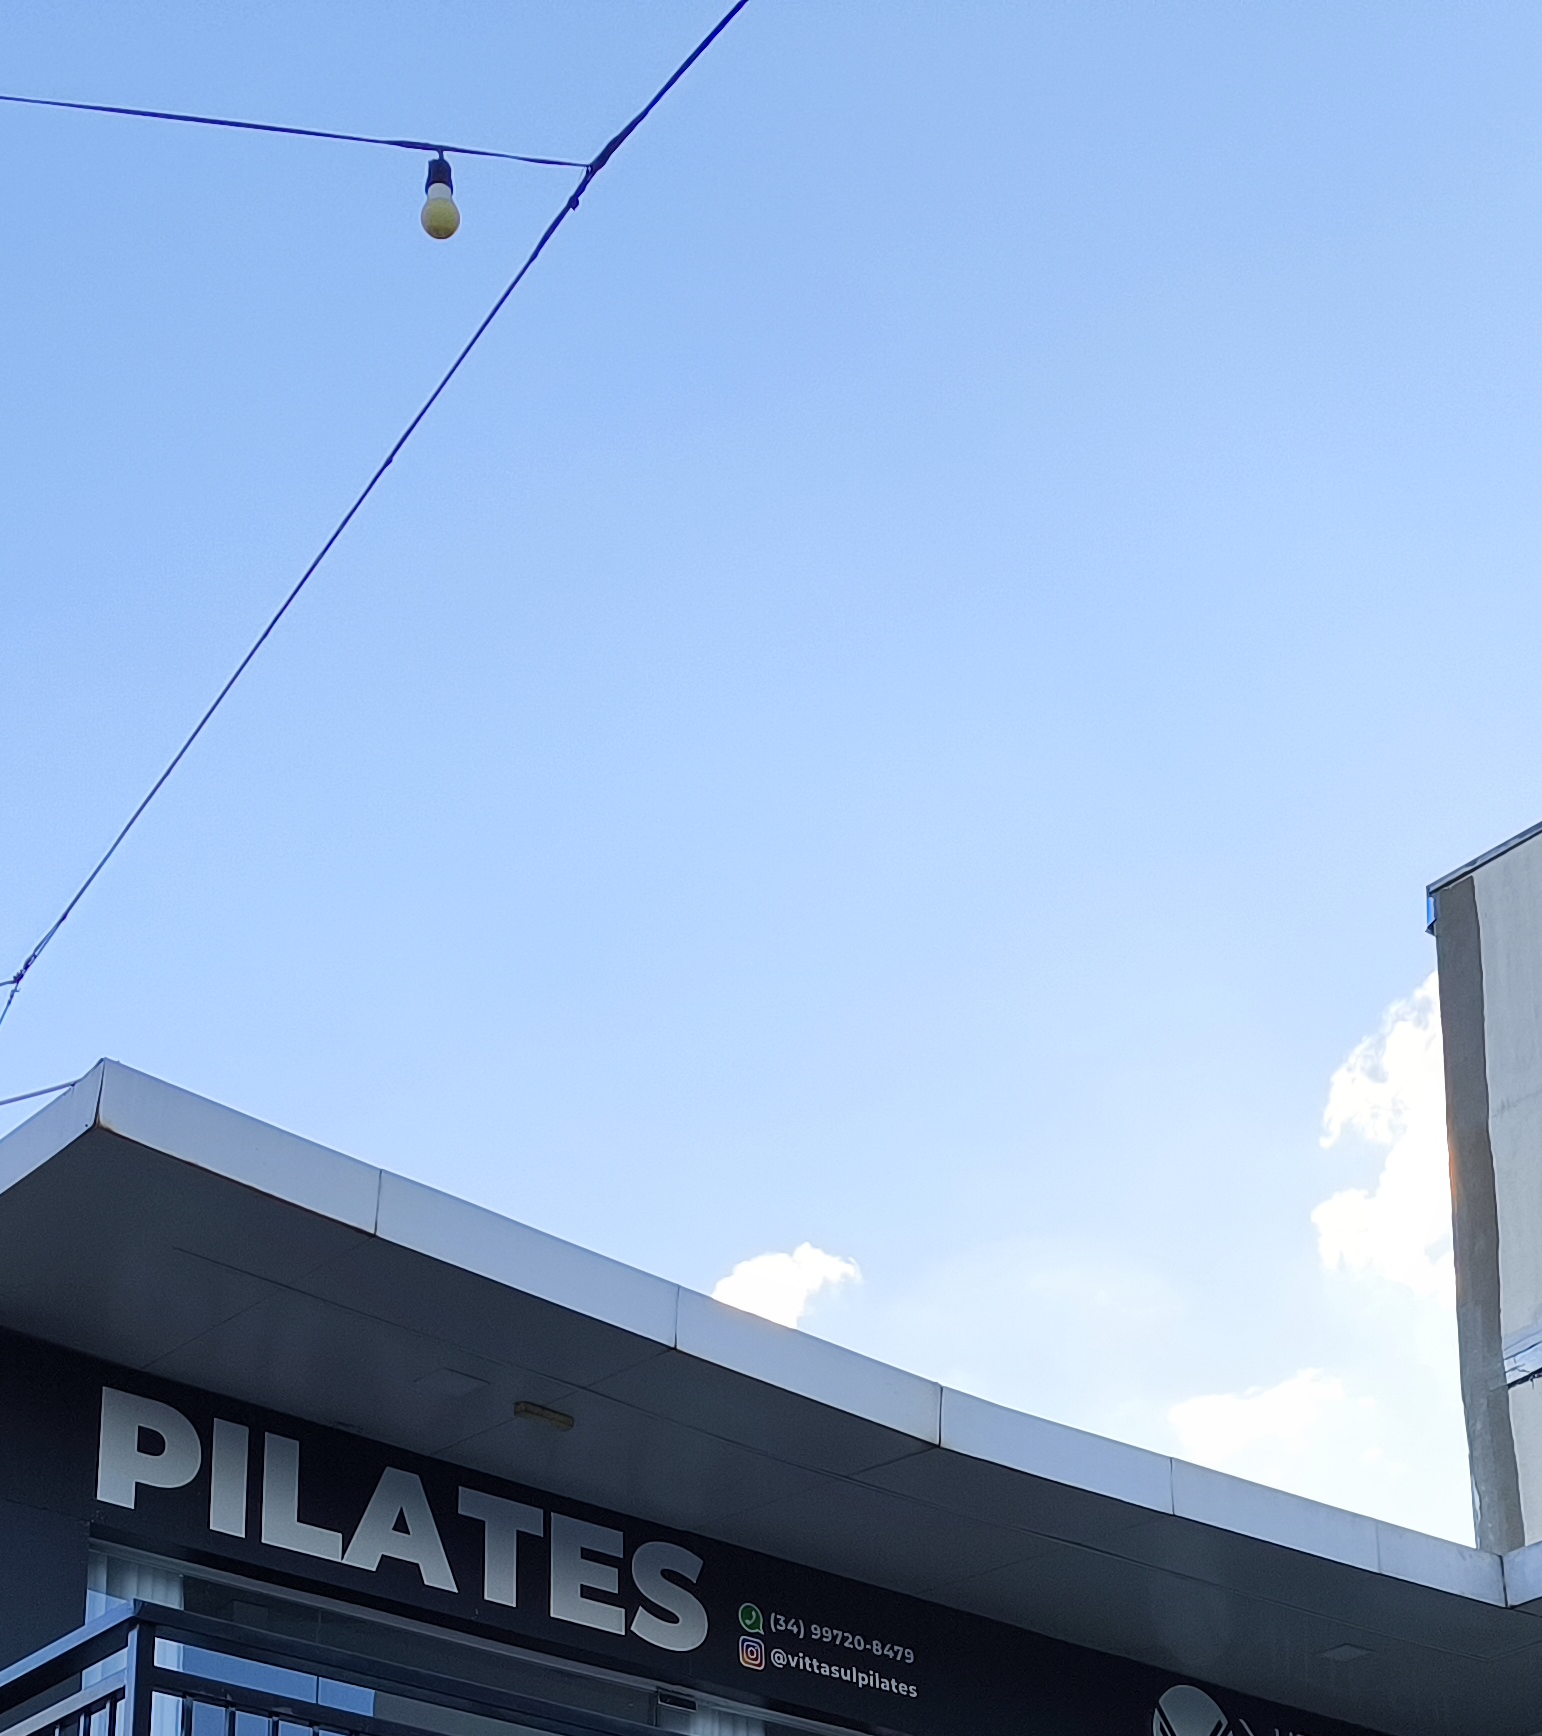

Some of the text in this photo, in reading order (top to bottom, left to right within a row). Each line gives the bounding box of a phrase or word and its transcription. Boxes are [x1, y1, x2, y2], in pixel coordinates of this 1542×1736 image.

[94, 1385, 710, 1653] PILATES
[770, 1612, 915, 1664] (34) 99720-8479
[770, 1648, 918, 1698] @vittasulpilates
